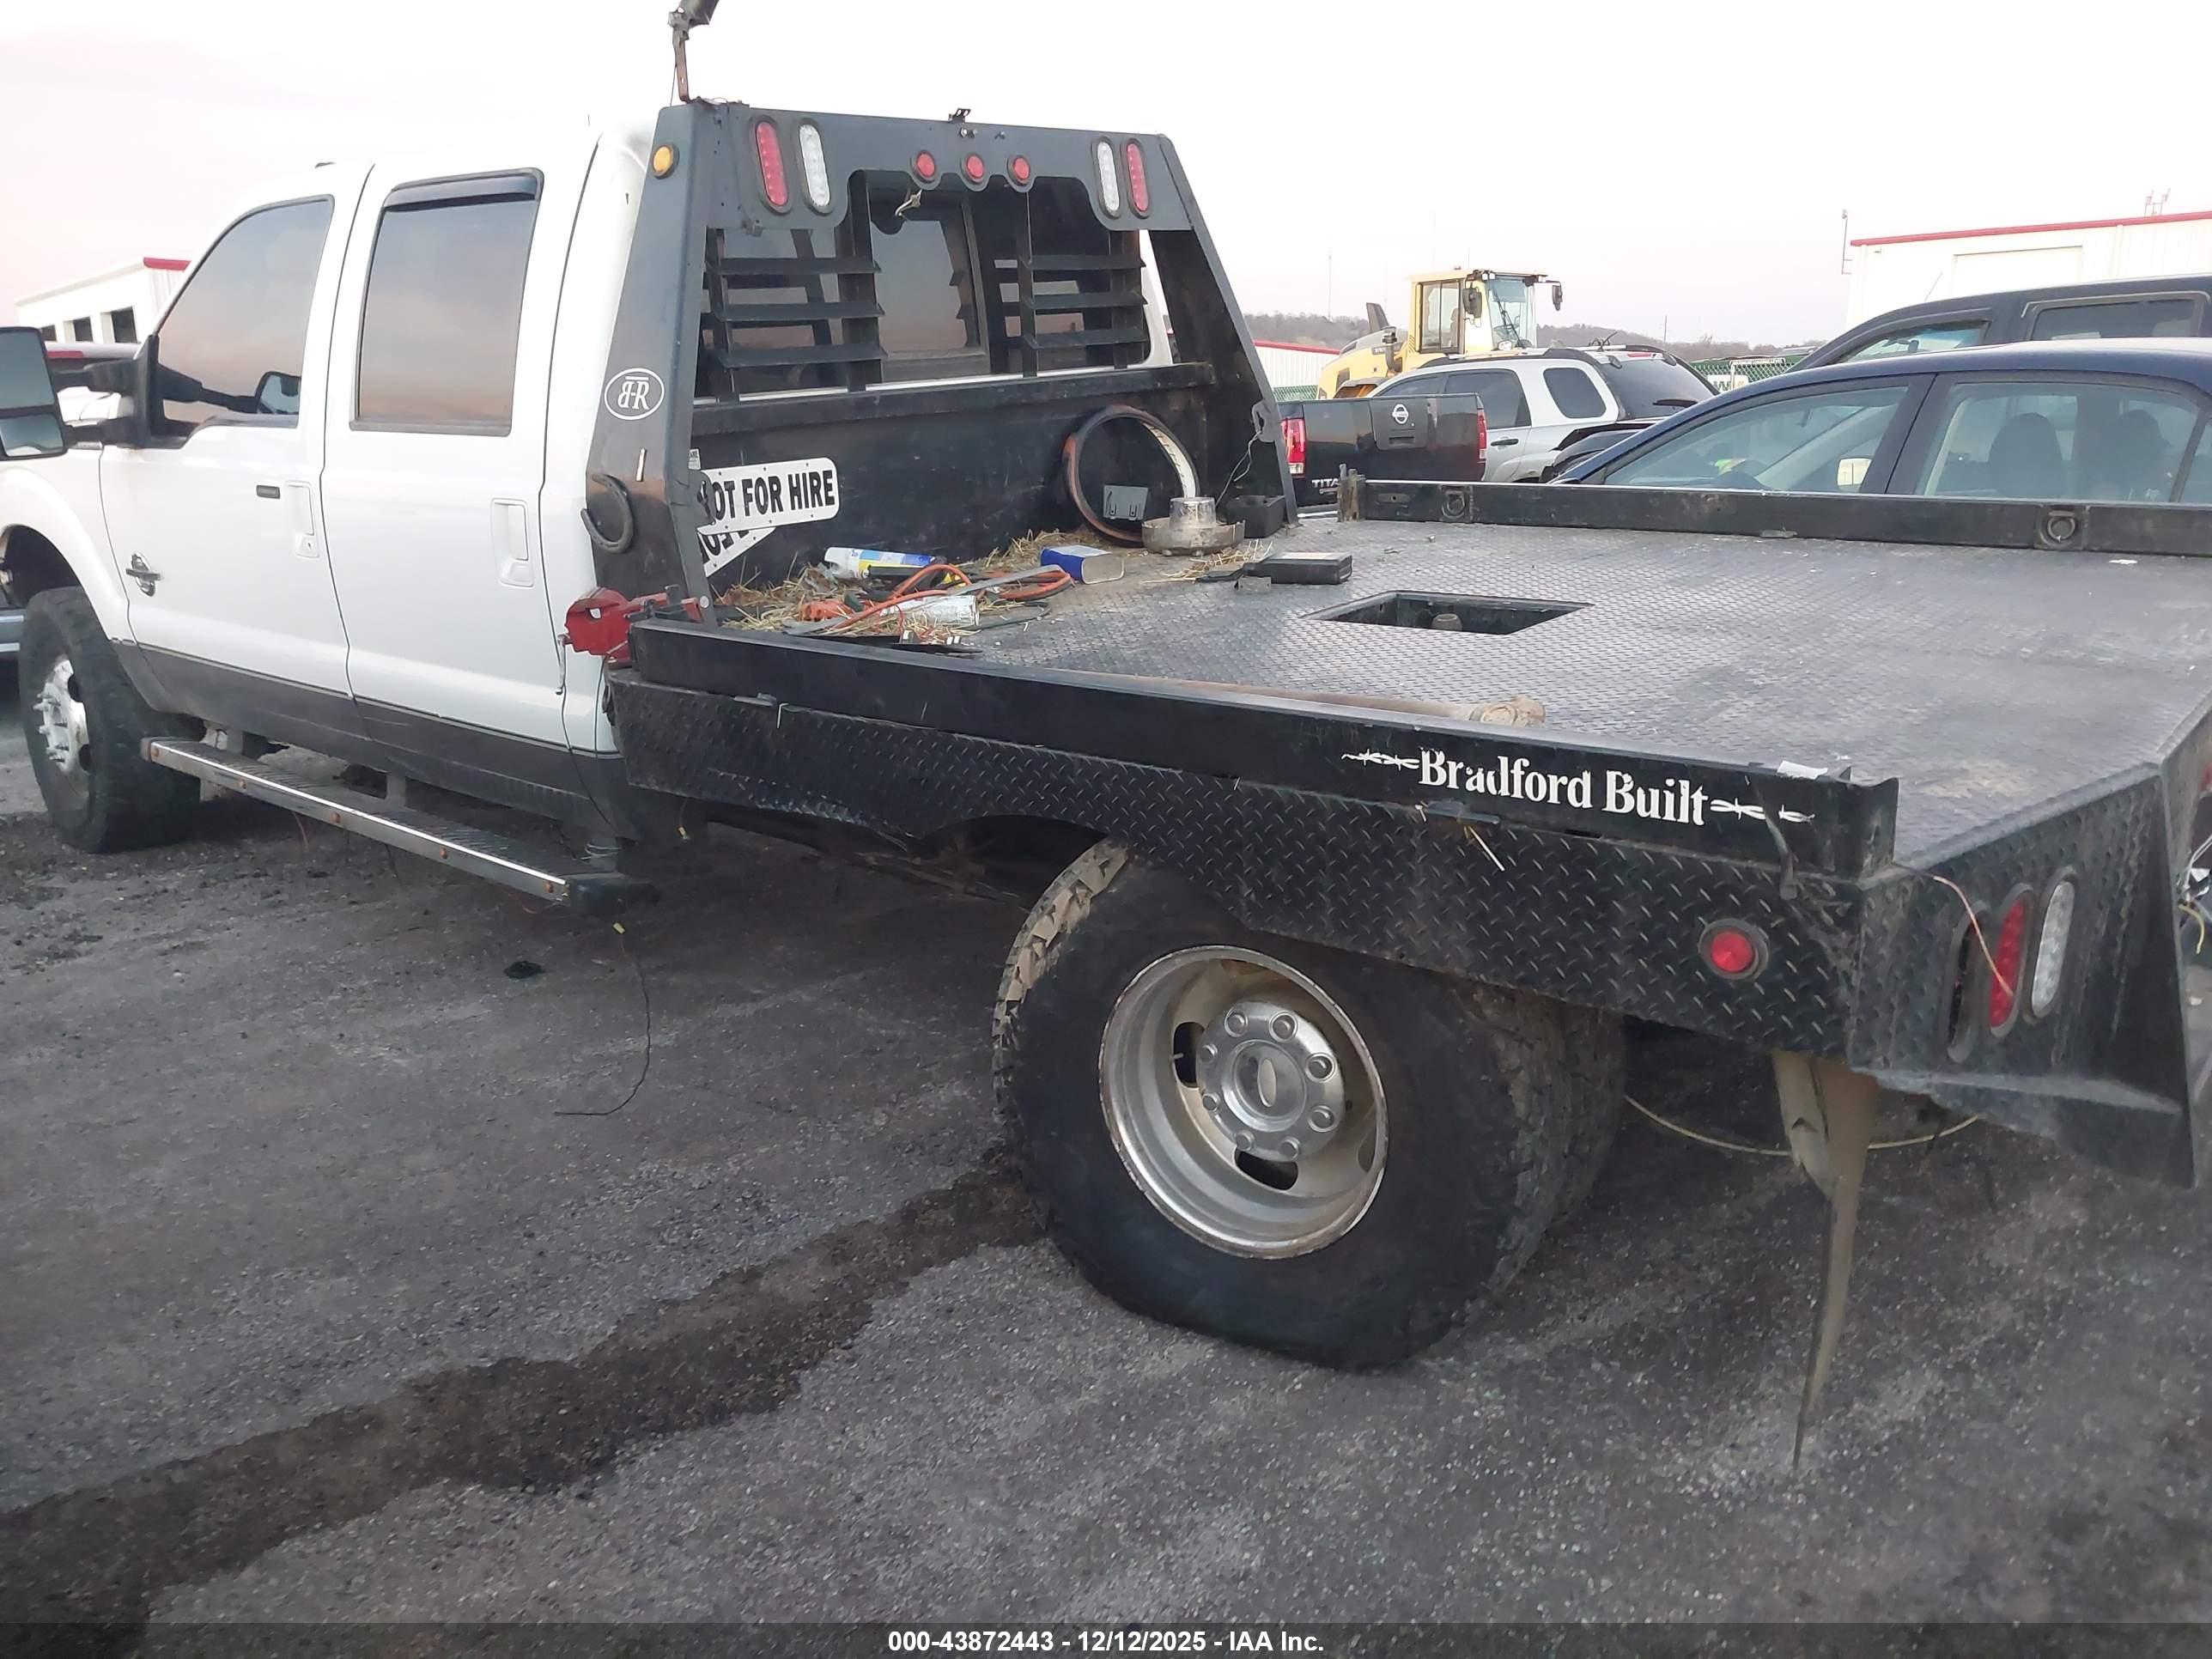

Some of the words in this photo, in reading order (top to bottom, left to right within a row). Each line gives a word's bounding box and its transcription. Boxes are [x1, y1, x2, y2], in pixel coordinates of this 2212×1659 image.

[711, 480, 736, 520] OT
[741, 476, 784, 517] FOR
[787, 470, 836, 511] HIRE
[1311, 477, 1340, 489] TITA
[1418, 748, 1593, 809] Bradford
[1602, 769, 1709, 825] Built
